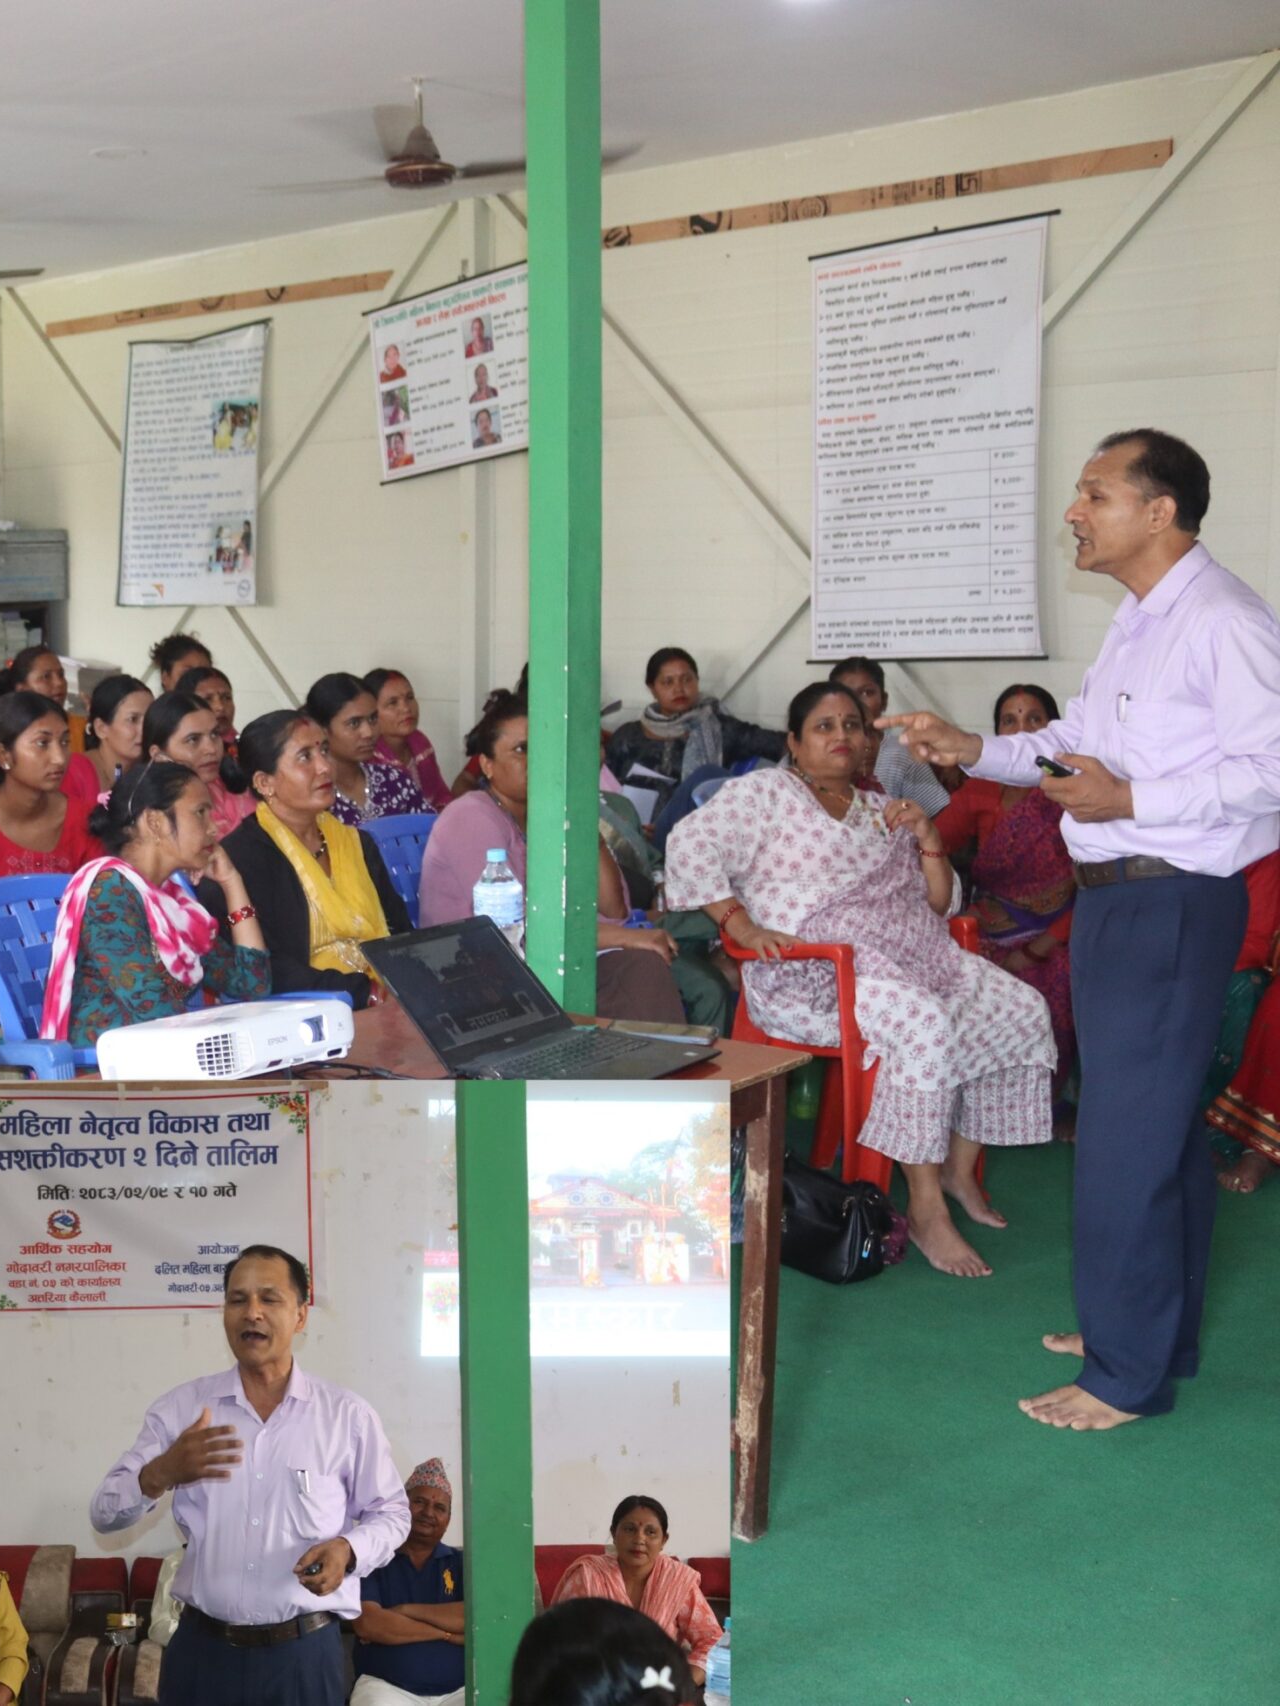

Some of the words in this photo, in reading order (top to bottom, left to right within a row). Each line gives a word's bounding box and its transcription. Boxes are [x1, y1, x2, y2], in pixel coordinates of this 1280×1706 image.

[0, 1109, 72, 1137] महिला
[79, 1110, 141, 1140] नेतृत्व
[148, 1109, 220, 1134] विकास
[227, 1112, 271, 1133] तथा
[133, 1147, 147, 1167] २
[156, 1140, 199, 1168] दिने
[206, 1138, 279, 1167] तालिम
[174, 1186, 185, 1199] र
[189, 1186, 208, 1198] १०
[213, 1181, 237, 1198] गते
[19, 1242, 62, 1255] आर्थिक
[66, 1242, 112, 1255] सहयोग
[198, 1242, 240, 1255] आयोजक
[6, 1260, 52, 1274] गोदावरी
[55, 1259, 127, 1273] नगरपालिका
[154, 1262, 180, 1275] दलित
[182, 1261, 211, 1275] महिला
[60, 1276, 74, 1287] को
[77, 1277, 121, 1288] कार्यालय
[69, 1290, 107, 1302] कैलाली
